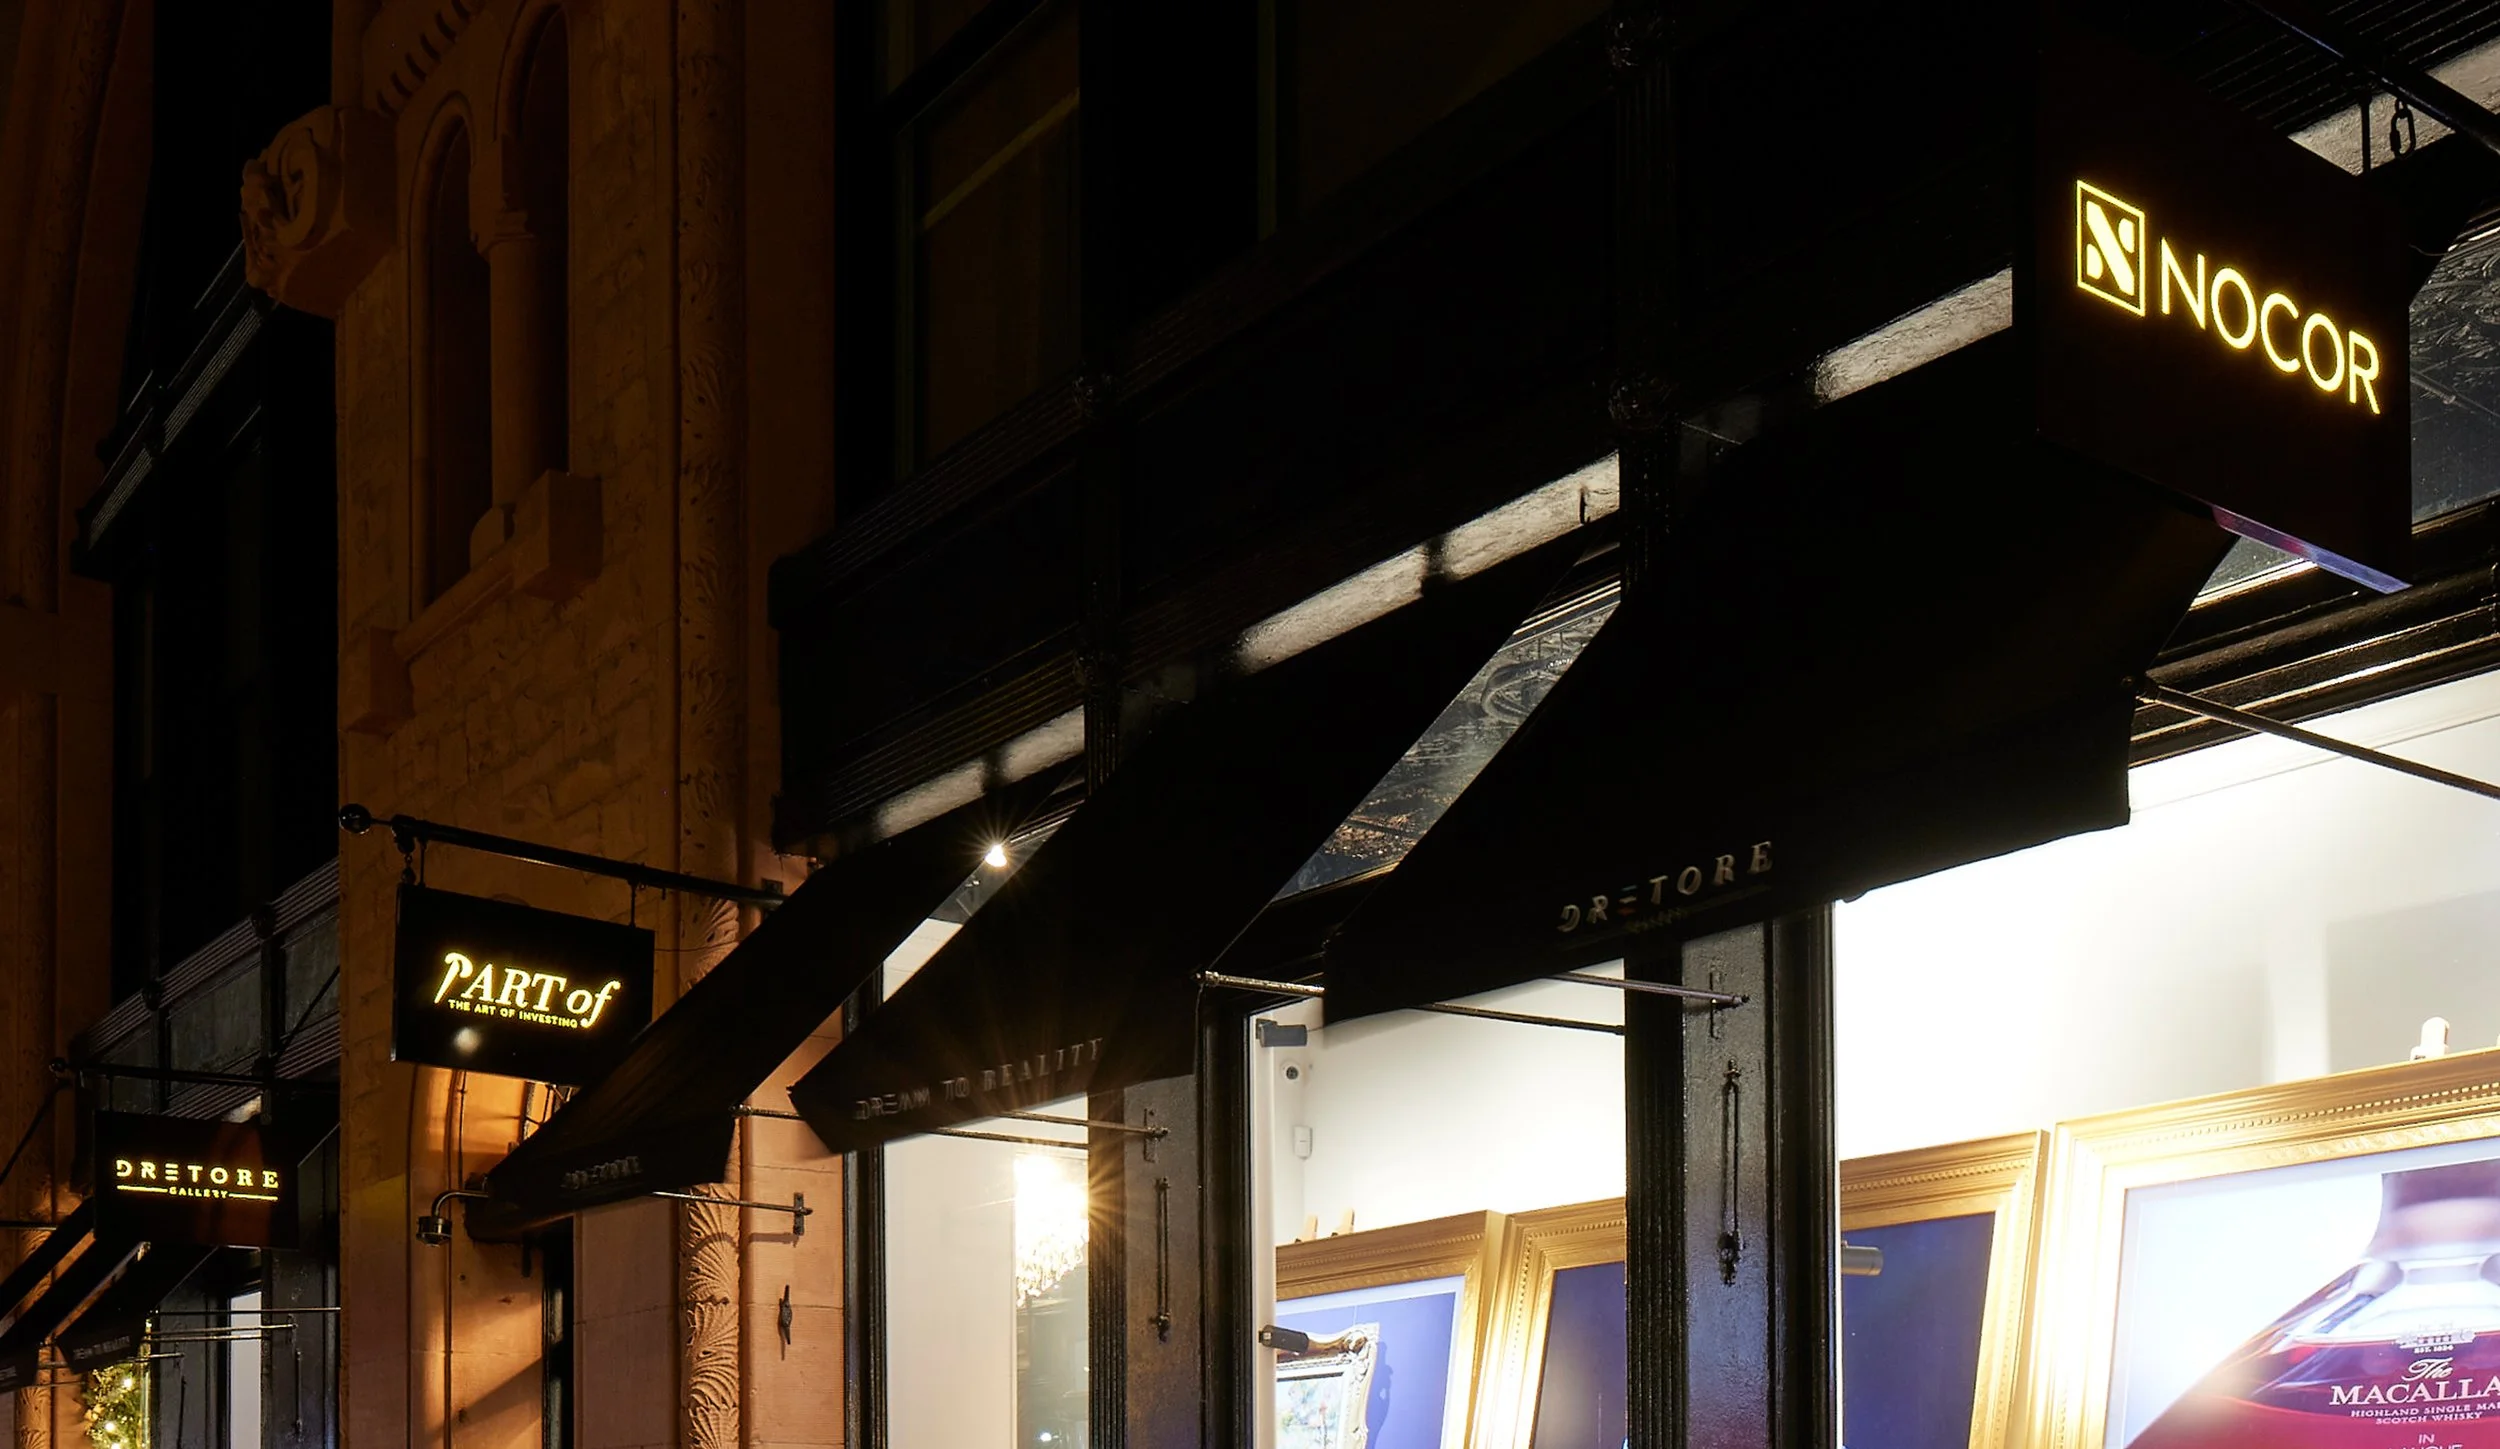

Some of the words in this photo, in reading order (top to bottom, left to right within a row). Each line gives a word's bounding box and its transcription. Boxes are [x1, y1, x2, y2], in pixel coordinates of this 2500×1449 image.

[2161, 237, 2381, 415] NOCOR
[1556, 839, 1774, 933] DRETORE
[434, 951, 567, 1012] PART
[566, 979, 622, 1029] of
[449, 999, 471, 1011] THE
[474, 1004, 497, 1015] ART
[500, 1008, 515, 1018] OF
[519, 1010, 578, 1029] INVESTING
[941, 1076, 970, 1101] TO
[115, 1159, 279, 1189] DRETORE
[168, 1186, 229, 1199] GALLERY
[2401, 1357, 2454, 1381] The
[2351, 1407, 2420, 1418] HIGHLAND
[2424, 1404, 2470, 1414] SINGLE
[2376, 1415, 2427, 1425] SCOTCH
[2432, 1411, 2484, 1422] WHISKY
[2418, 1434, 2435, 1444] IN
